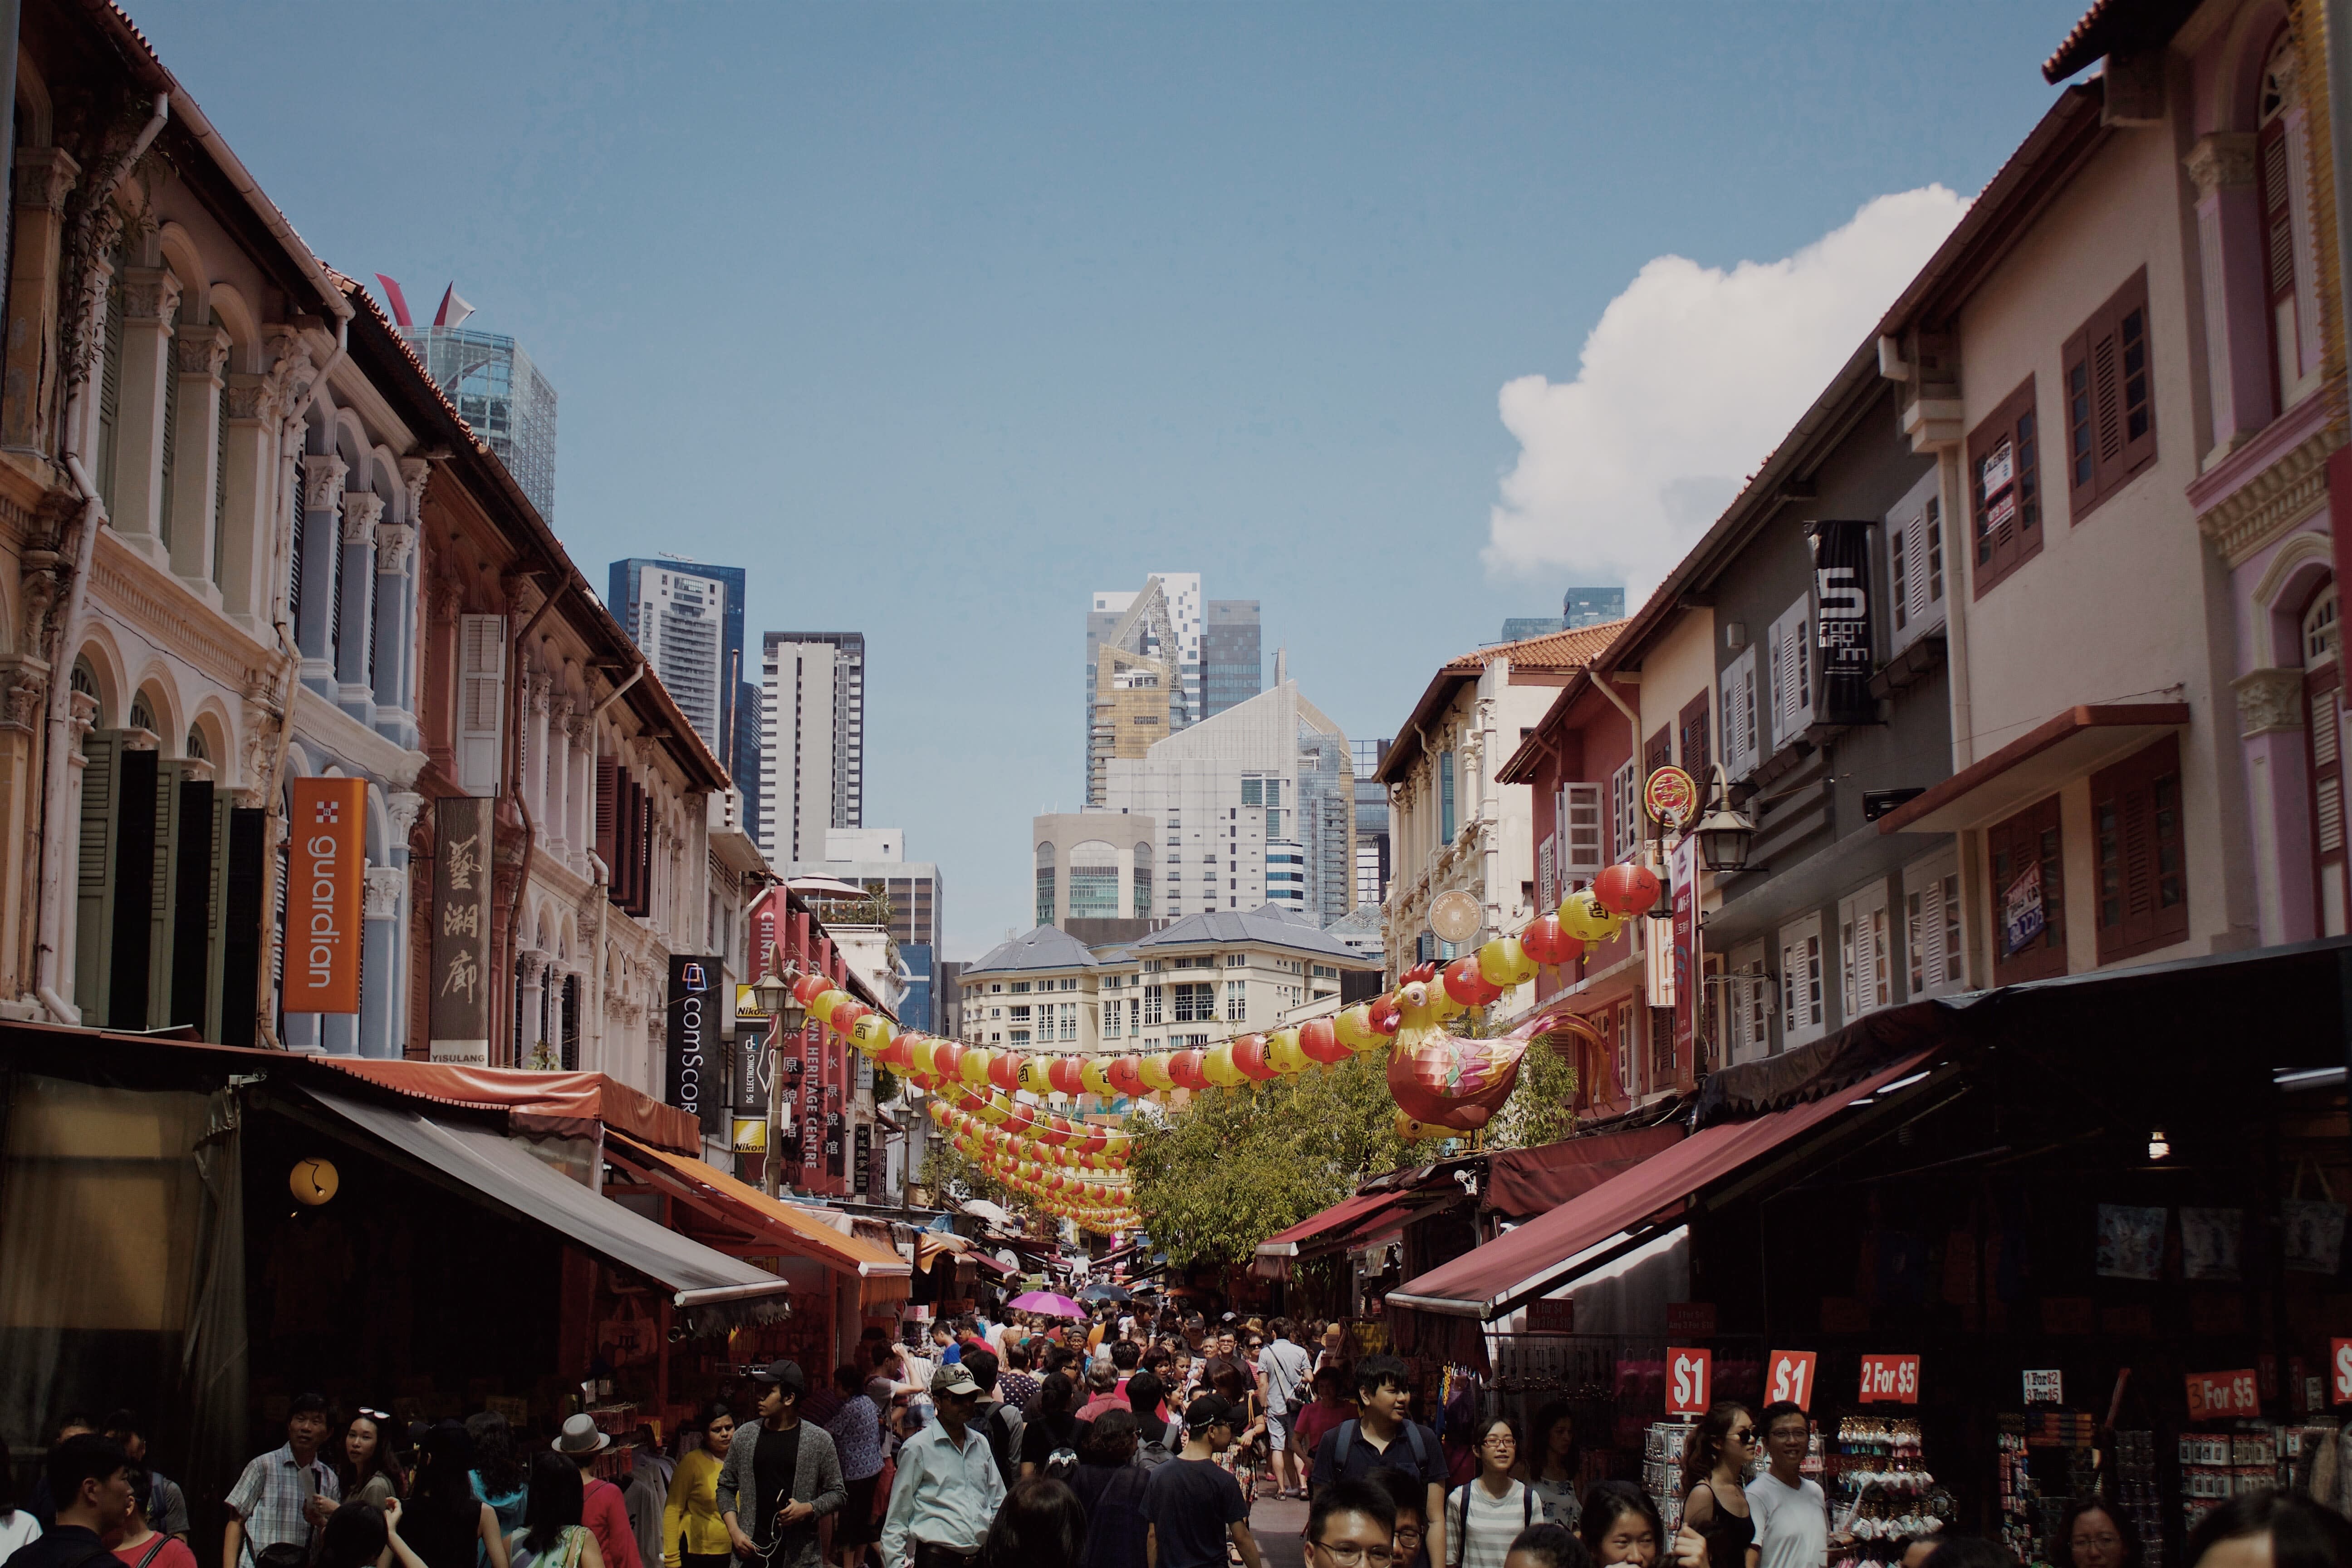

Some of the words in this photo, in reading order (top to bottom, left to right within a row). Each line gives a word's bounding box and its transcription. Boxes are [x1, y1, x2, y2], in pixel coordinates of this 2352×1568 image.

[1818, 567, 1866, 619] 5
[1819, 622, 1866, 635] FOOT
[1818, 635, 1855, 648] WAY
[307, 836, 340, 988] guardian
[1436, 896, 1453, 914] COINS
[737, 1007, 766, 1016] Niko
[432, 1054, 485, 1063] YISULANG
[746, 1054, 755, 1092] ELECTRONICS
[806, 1047, 818, 1112] HERITAGE
[745, 1094, 754, 1103] DG
[734, 1142, 764, 1153] Nikon
[805, 1117, 818, 1169] CENTRE
[1535, 1301, 1539, 1314] 1
[1542, 1302, 1552, 1314] For
[1547, 1316, 1557, 1329] For
[1674, 1353, 1704, 1408] $1
[1773, 1357, 1807, 1404] $1
[1862, 1362, 1871, 1392] 2
[1873, 1362, 1895, 1393] For
[1898, 1360, 1915, 1396] $5
[2025, 1372, 2030, 1385] 1
[2032, 1372, 2047, 1385] For
[2047, 1372, 2058, 1385] $2
[2025, 1388, 2032, 1401] 3
[2189, 1382, 2202, 1409] 3
[2203, 1380, 2230, 1410] For
[2233, 1376, 2254, 1411] $5
